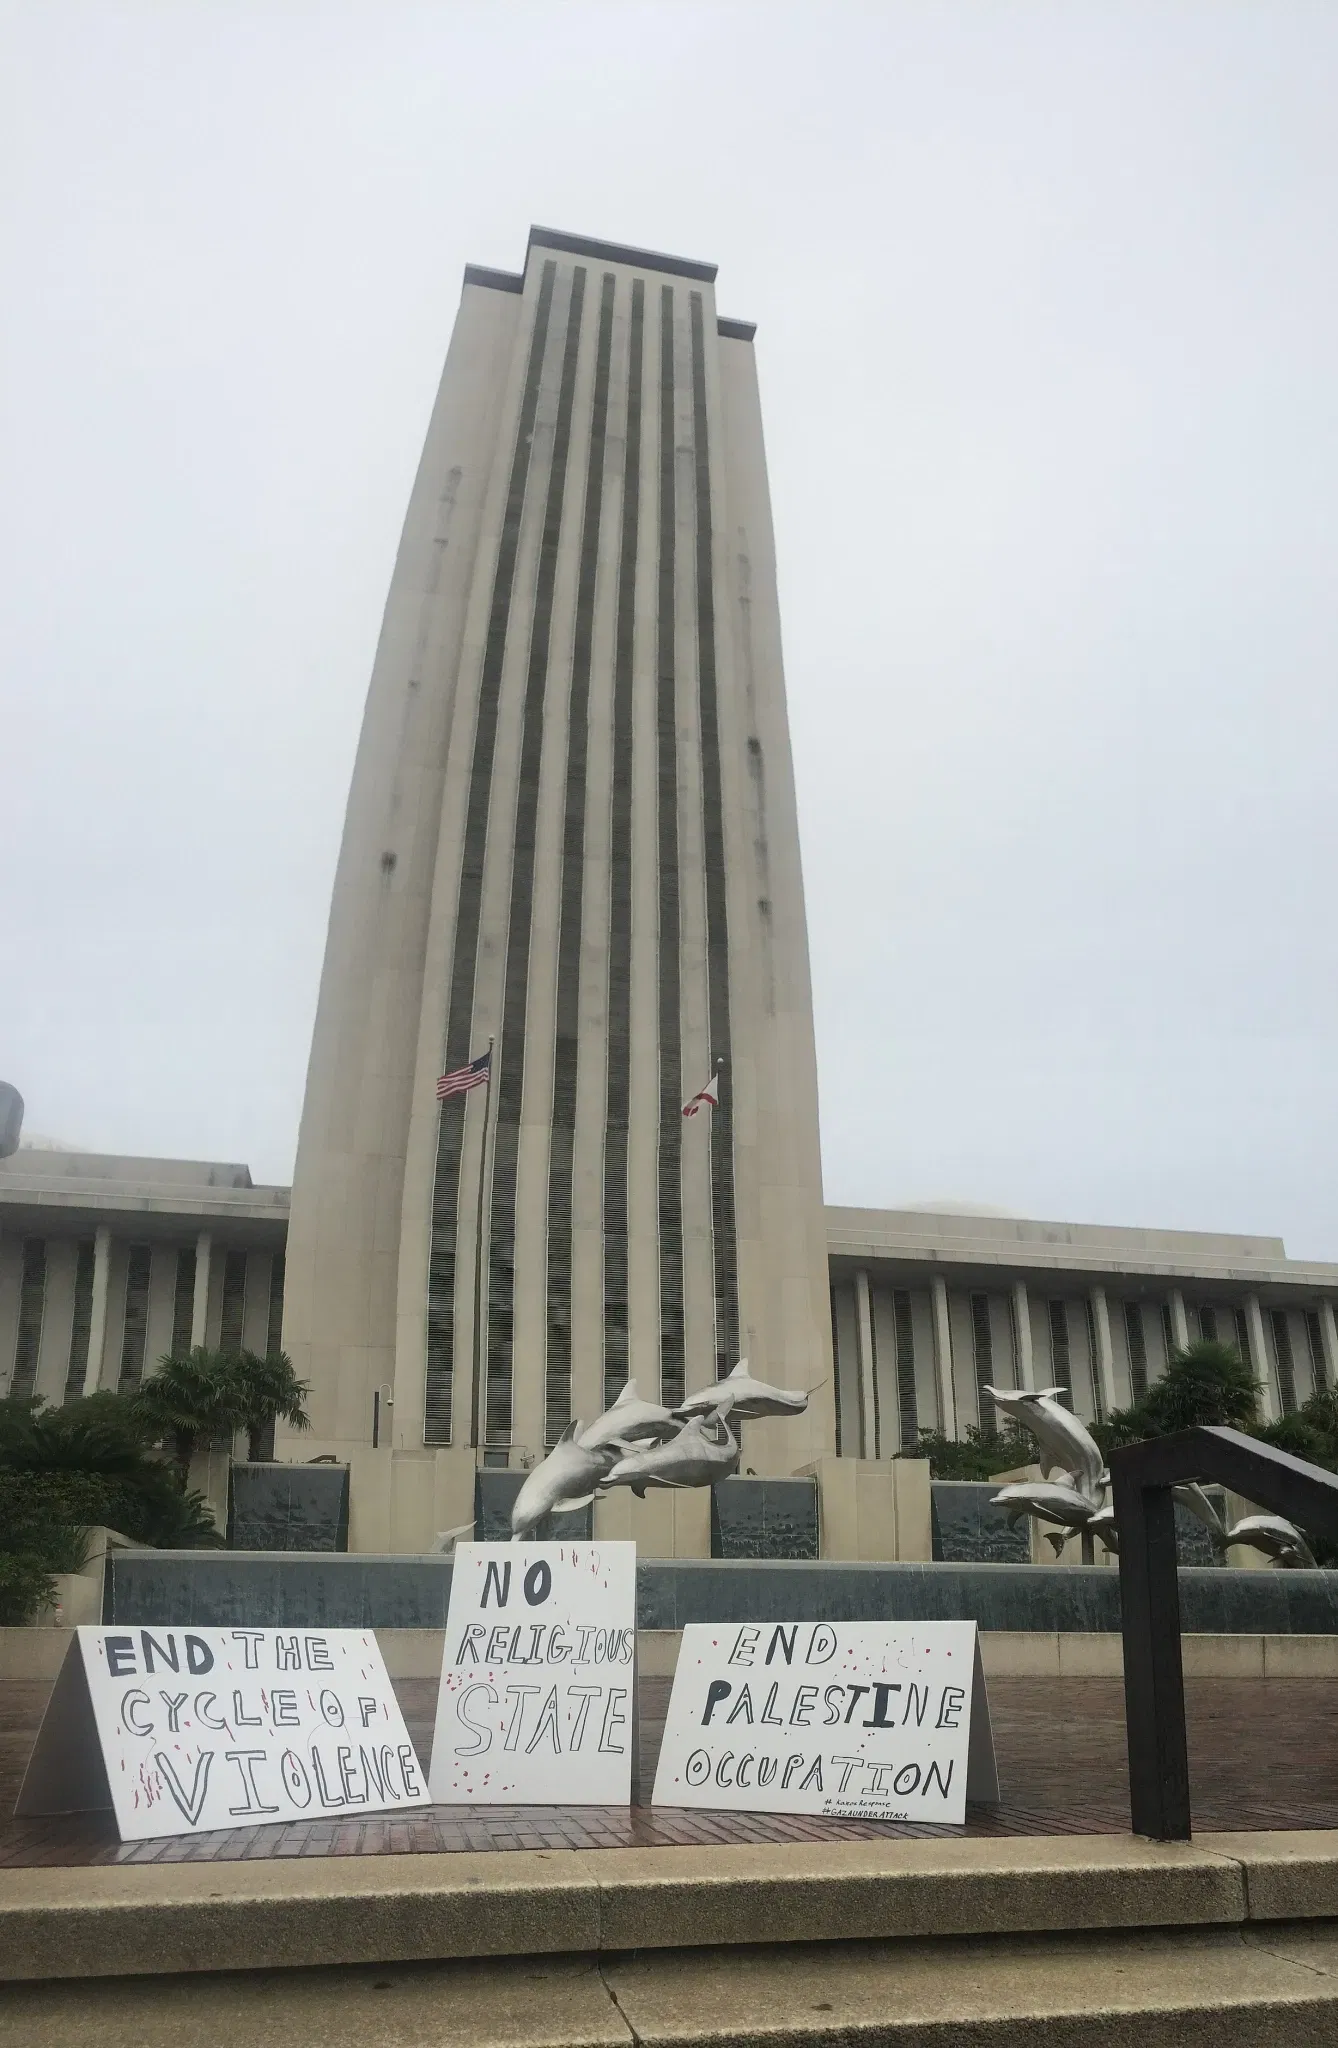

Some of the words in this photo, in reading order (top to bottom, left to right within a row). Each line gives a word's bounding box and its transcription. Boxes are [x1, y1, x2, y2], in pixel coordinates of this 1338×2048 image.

[480, 1560, 552, 1608] NO
[105, 1630, 214, 1676] END
[232, 1631, 334, 1671] THE
[456, 1623, 633, 1665] RELIGIOUS
[728, 1624, 837, 1666] END
[121, 1689, 300, 1736] CYCLE
[320, 1689, 376, 1727] OF
[454, 1683, 627, 1756] STATE
[701, 1679, 965, 1728] PALESTINE
[155, 1745, 420, 1825] VIOLENCE
[685, 1749, 953, 1798] OCCUPATION
